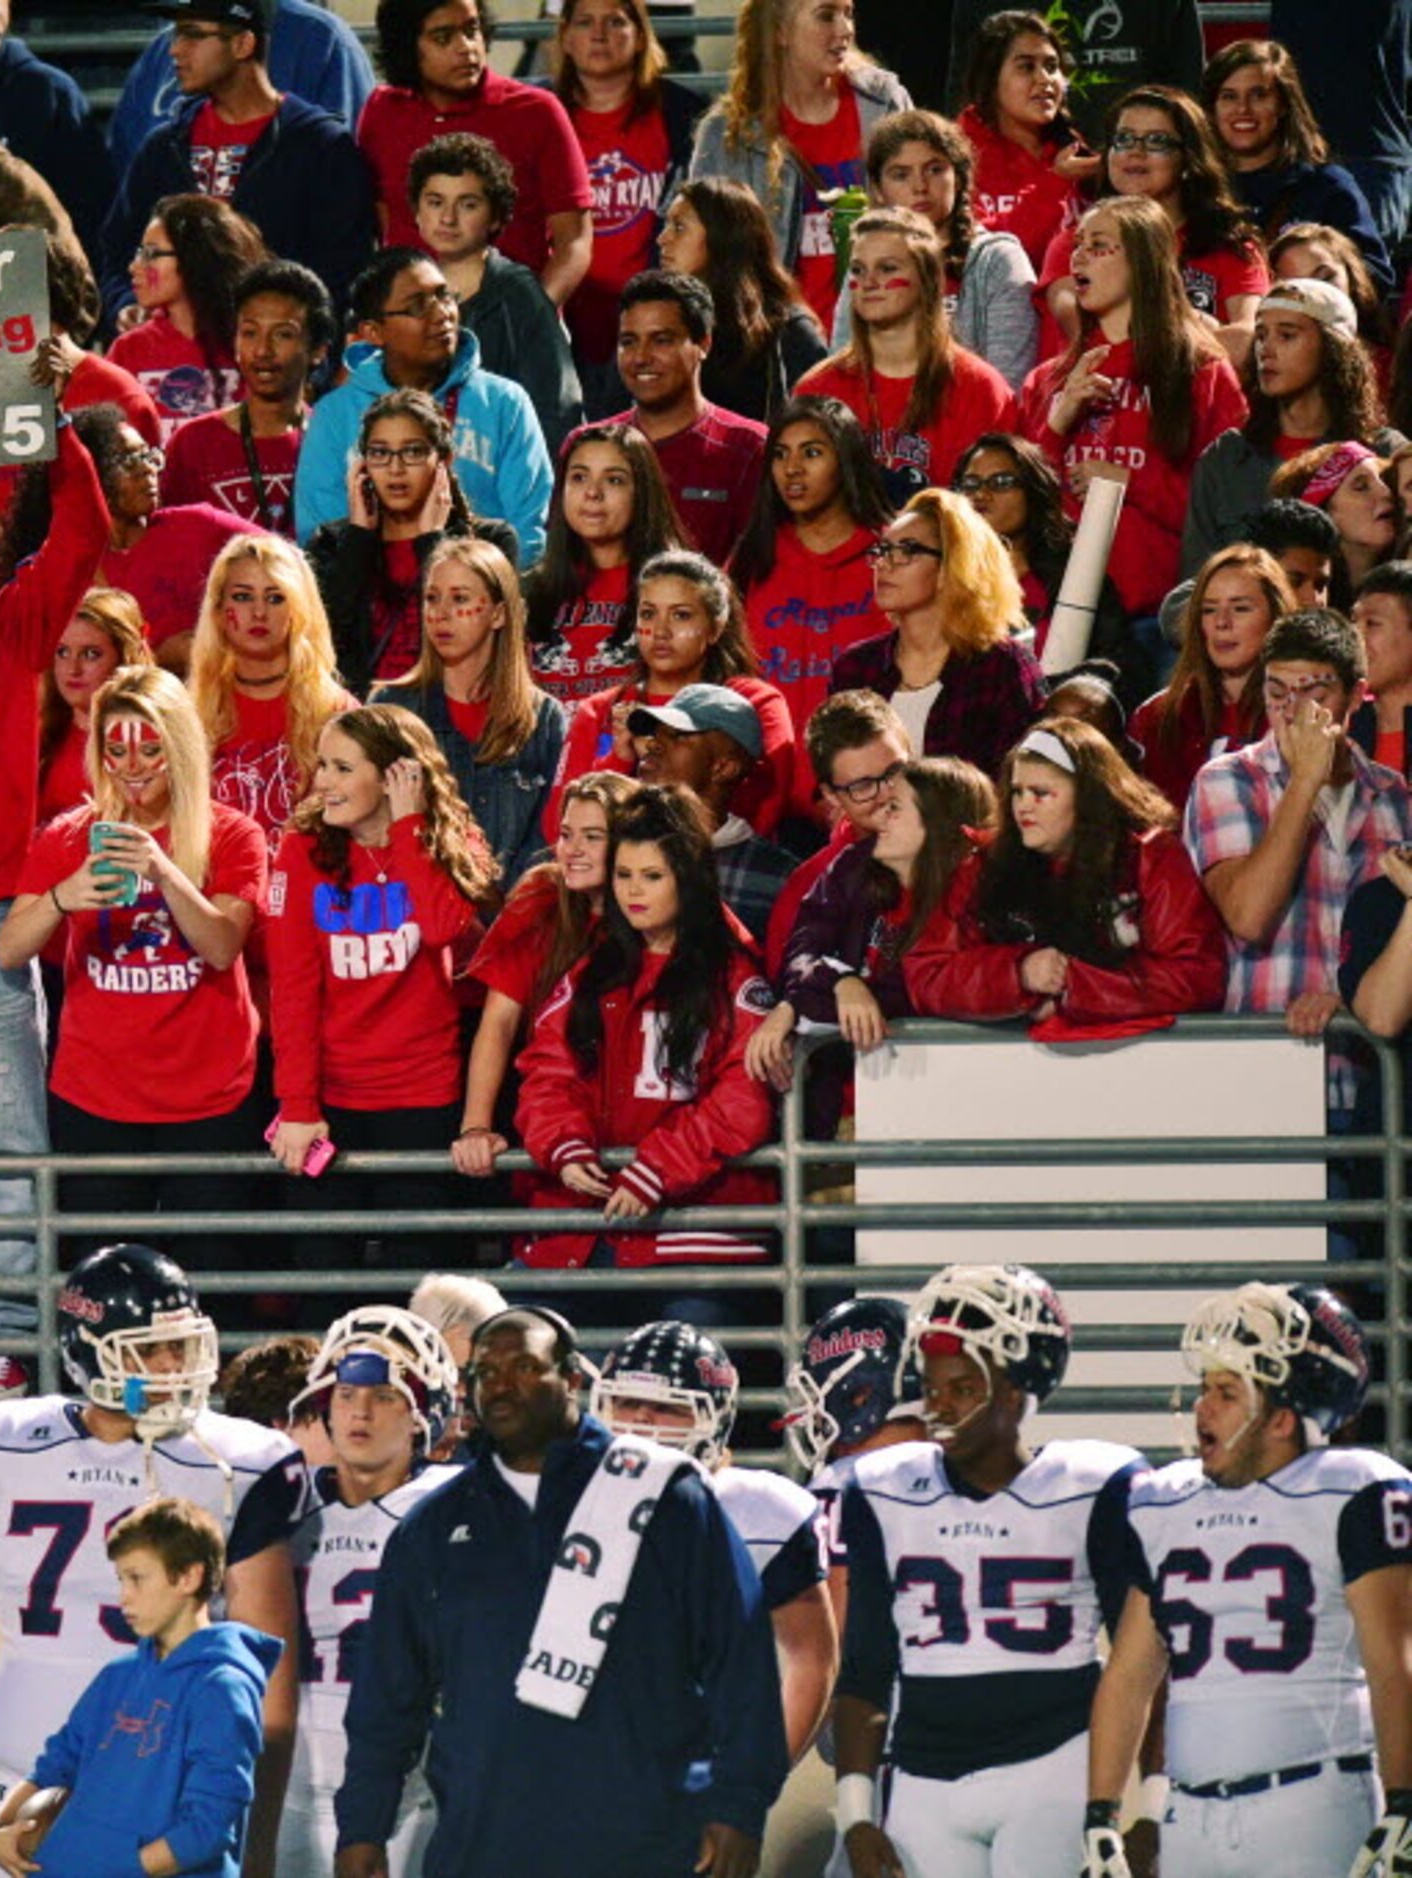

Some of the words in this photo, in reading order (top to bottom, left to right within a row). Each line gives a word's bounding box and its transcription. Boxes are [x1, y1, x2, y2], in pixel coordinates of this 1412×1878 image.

[330, 922, 420, 980] RED
[87, 954, 205, 995] RAIDERS
[808, 1326, 887, 1364] Raiders
[81, 1468, 126, 1486] RYAN
[322, 1535, 365, 1555] RYAN
[896, 1556, 1073, 1655] 35
[1159, 1543, 1316, 1682] 63
[528, 1650, 598, 1690] ADE
